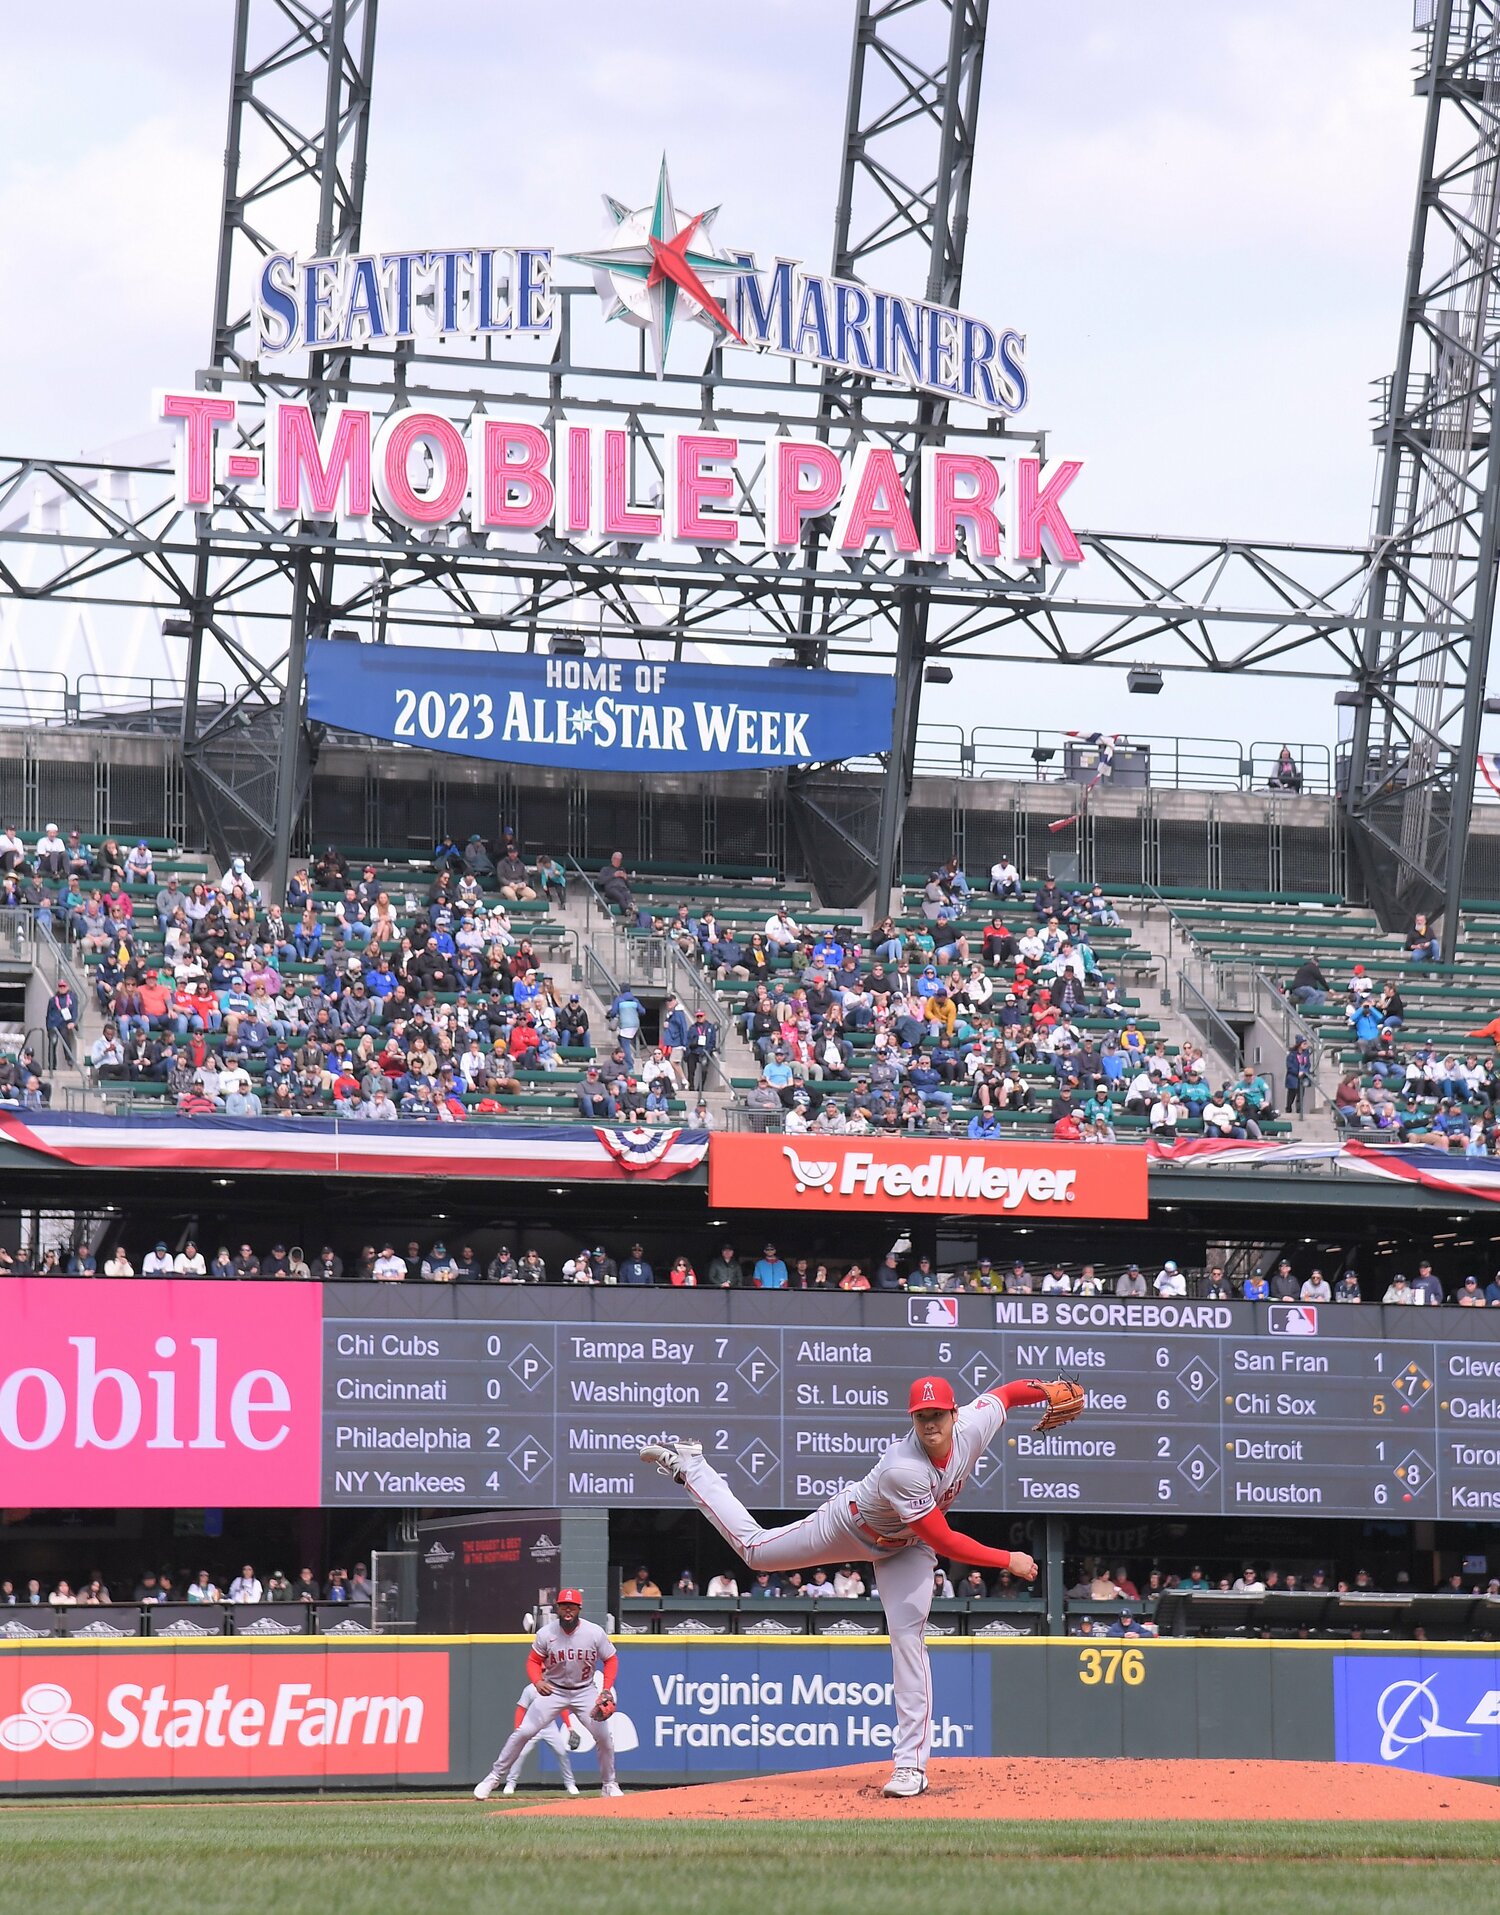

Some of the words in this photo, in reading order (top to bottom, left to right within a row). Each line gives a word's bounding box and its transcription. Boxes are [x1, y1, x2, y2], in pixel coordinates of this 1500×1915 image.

[258, 247, 556, 357] SEATTLE
[729, 249, 1030, 416] MARINERS
[161, 392, 740, 542] T-MOBILE
[777, 441, 1086, 563] PARK
[546, 660, 623, 693] HOME
[635, 665, 667, 695] OF
[394, 688, 494, 741] 2023
[693, 701, 811, 757] WEEK
[996, 1301, 1049, 1325] MLB
[1055, 1302, 1233, 1330] SCOREBOARD
[336, 1334, 374, 1356] Chi
[383, 1335, 440, 1357] Cubs
[487, 1335, 501, 1356] 0
[571, 1337, 647, 1362] Tampa
[652, 1338, 694, 1364] Bay
[715, 1338, 729, 1358] 7
[796, 1341, 872, 1363] Atlanta
[938, 1343, 952, 1363] 5
[1016, 1345, 1047, 1366] NY
[1055, 1347, 1106, 1367] Mets
[1155, 1347, 1170, 1368] 6
[524, 1359, 538, 1379] P
[751, 1362, 766, 1382] F
[1233, 1350, 1275, 1372] San
[1281, 1351, 1329, 1373] Fran
[1374, 1352, 1384, 1373] 1
[974, 1366, 987, 1386] F
[1189, 1370, 1203, 1391] 9
[1405, 1376, 1417, 1396] 7
[0, 1335, 291, 1451] obile
[336, 1378, 447, 1401] Cincinnati
[487, 1379, 501, 1400] 0
[571, 1380, 700, 1408] Washington
[715, 1381, 729, 1402] 2
[796, 1384, 825, 1406] St.
[832, 1384, 889, 1406] Louis
[922, 1381, 935, 1401] A
[1156, 1389, 1170, 1410] 6
[1234, 1391, 1271, 1414] Chi
[1276, 1392, 1317, 1416] Sox
[1372, 1394, 1387, 1416] 5
[336, 1426, 471, 1453] Philadelphia
[486, 1426, 501, 1448] 2
[715, 1429, 729, 1450] 2
[1018, 1434, 1117, 1457] Baltimore
[1157, 1437, 1171, 1457] 2
[1235, 1438, 1304, 1461] Detroit
[1375, 1441, 1385, 1462] 1
[523, 1450, 538, 1470] F
[751, 1453, 766, 1473] F
[974, 1456, 988, 1476] F
[1190, 1460, 1205, 1481] 9
[335, 1470, 366, 1492] NY
[373, 1470, 466, 1493] Yankees
[485, 1470, 500, 1491] 4
[569, 1471, 634, 1494] Miami
[1406, 1464, 1421, 1486] 8
[1018, 1478, 1081, 1499] Texas
[1158, 1479, 1172, 1500] 5
[1236, 1481, 1322, 1504] Houston
[1374, 1484, 1388, 1504] 6
[550, 1648, 597, 1665] ANGELS
[1078, 1648, 1146, 1687] 376
[582, 1666, 591, 1681] 2
[651, 1673, 783, 1716] Virginia
[654, 1714, 839, 1748] Franciscan
